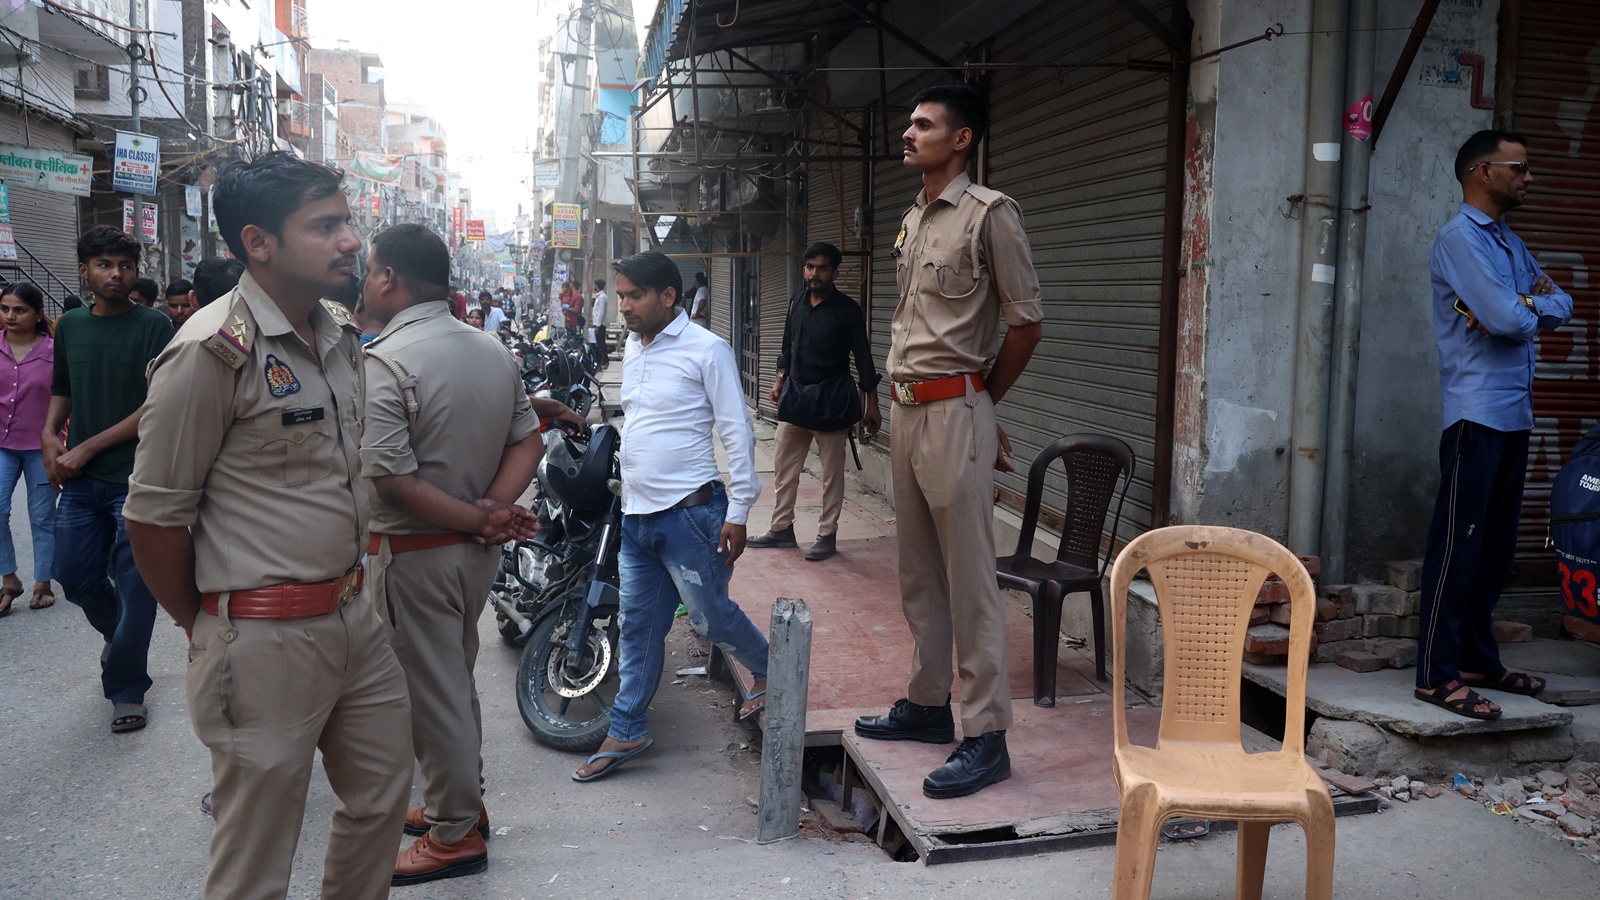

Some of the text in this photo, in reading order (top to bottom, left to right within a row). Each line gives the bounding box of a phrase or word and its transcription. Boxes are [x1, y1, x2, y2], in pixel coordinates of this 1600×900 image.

[0, 152, 32, 169] लोबल
[116, 148, 155, 163] JHA CLASSES
